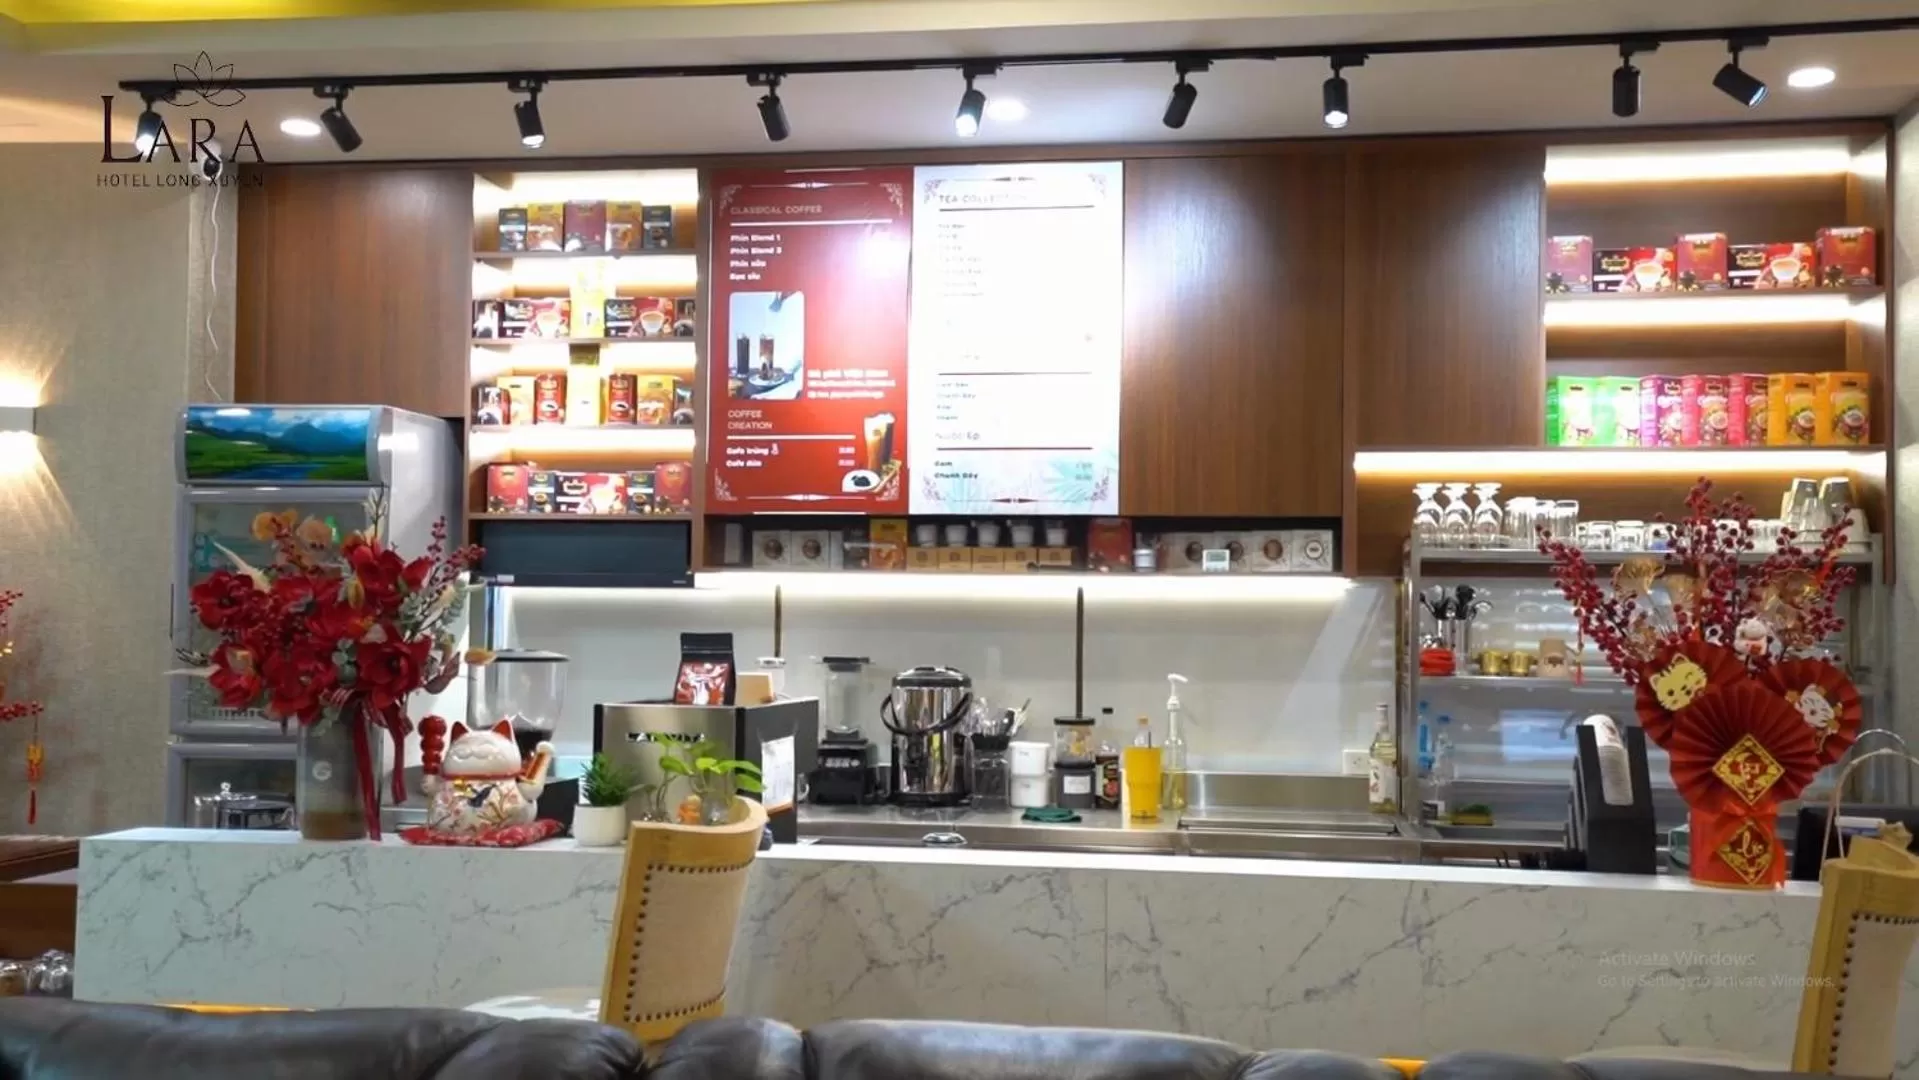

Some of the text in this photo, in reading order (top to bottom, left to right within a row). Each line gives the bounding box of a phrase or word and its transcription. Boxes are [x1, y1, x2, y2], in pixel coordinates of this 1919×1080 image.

[730, 204, 823, 215] CLASSICAL COFFEE
[728, 409, 762, 419] COFFEE
[728, 421, 772, 430] CREATION
